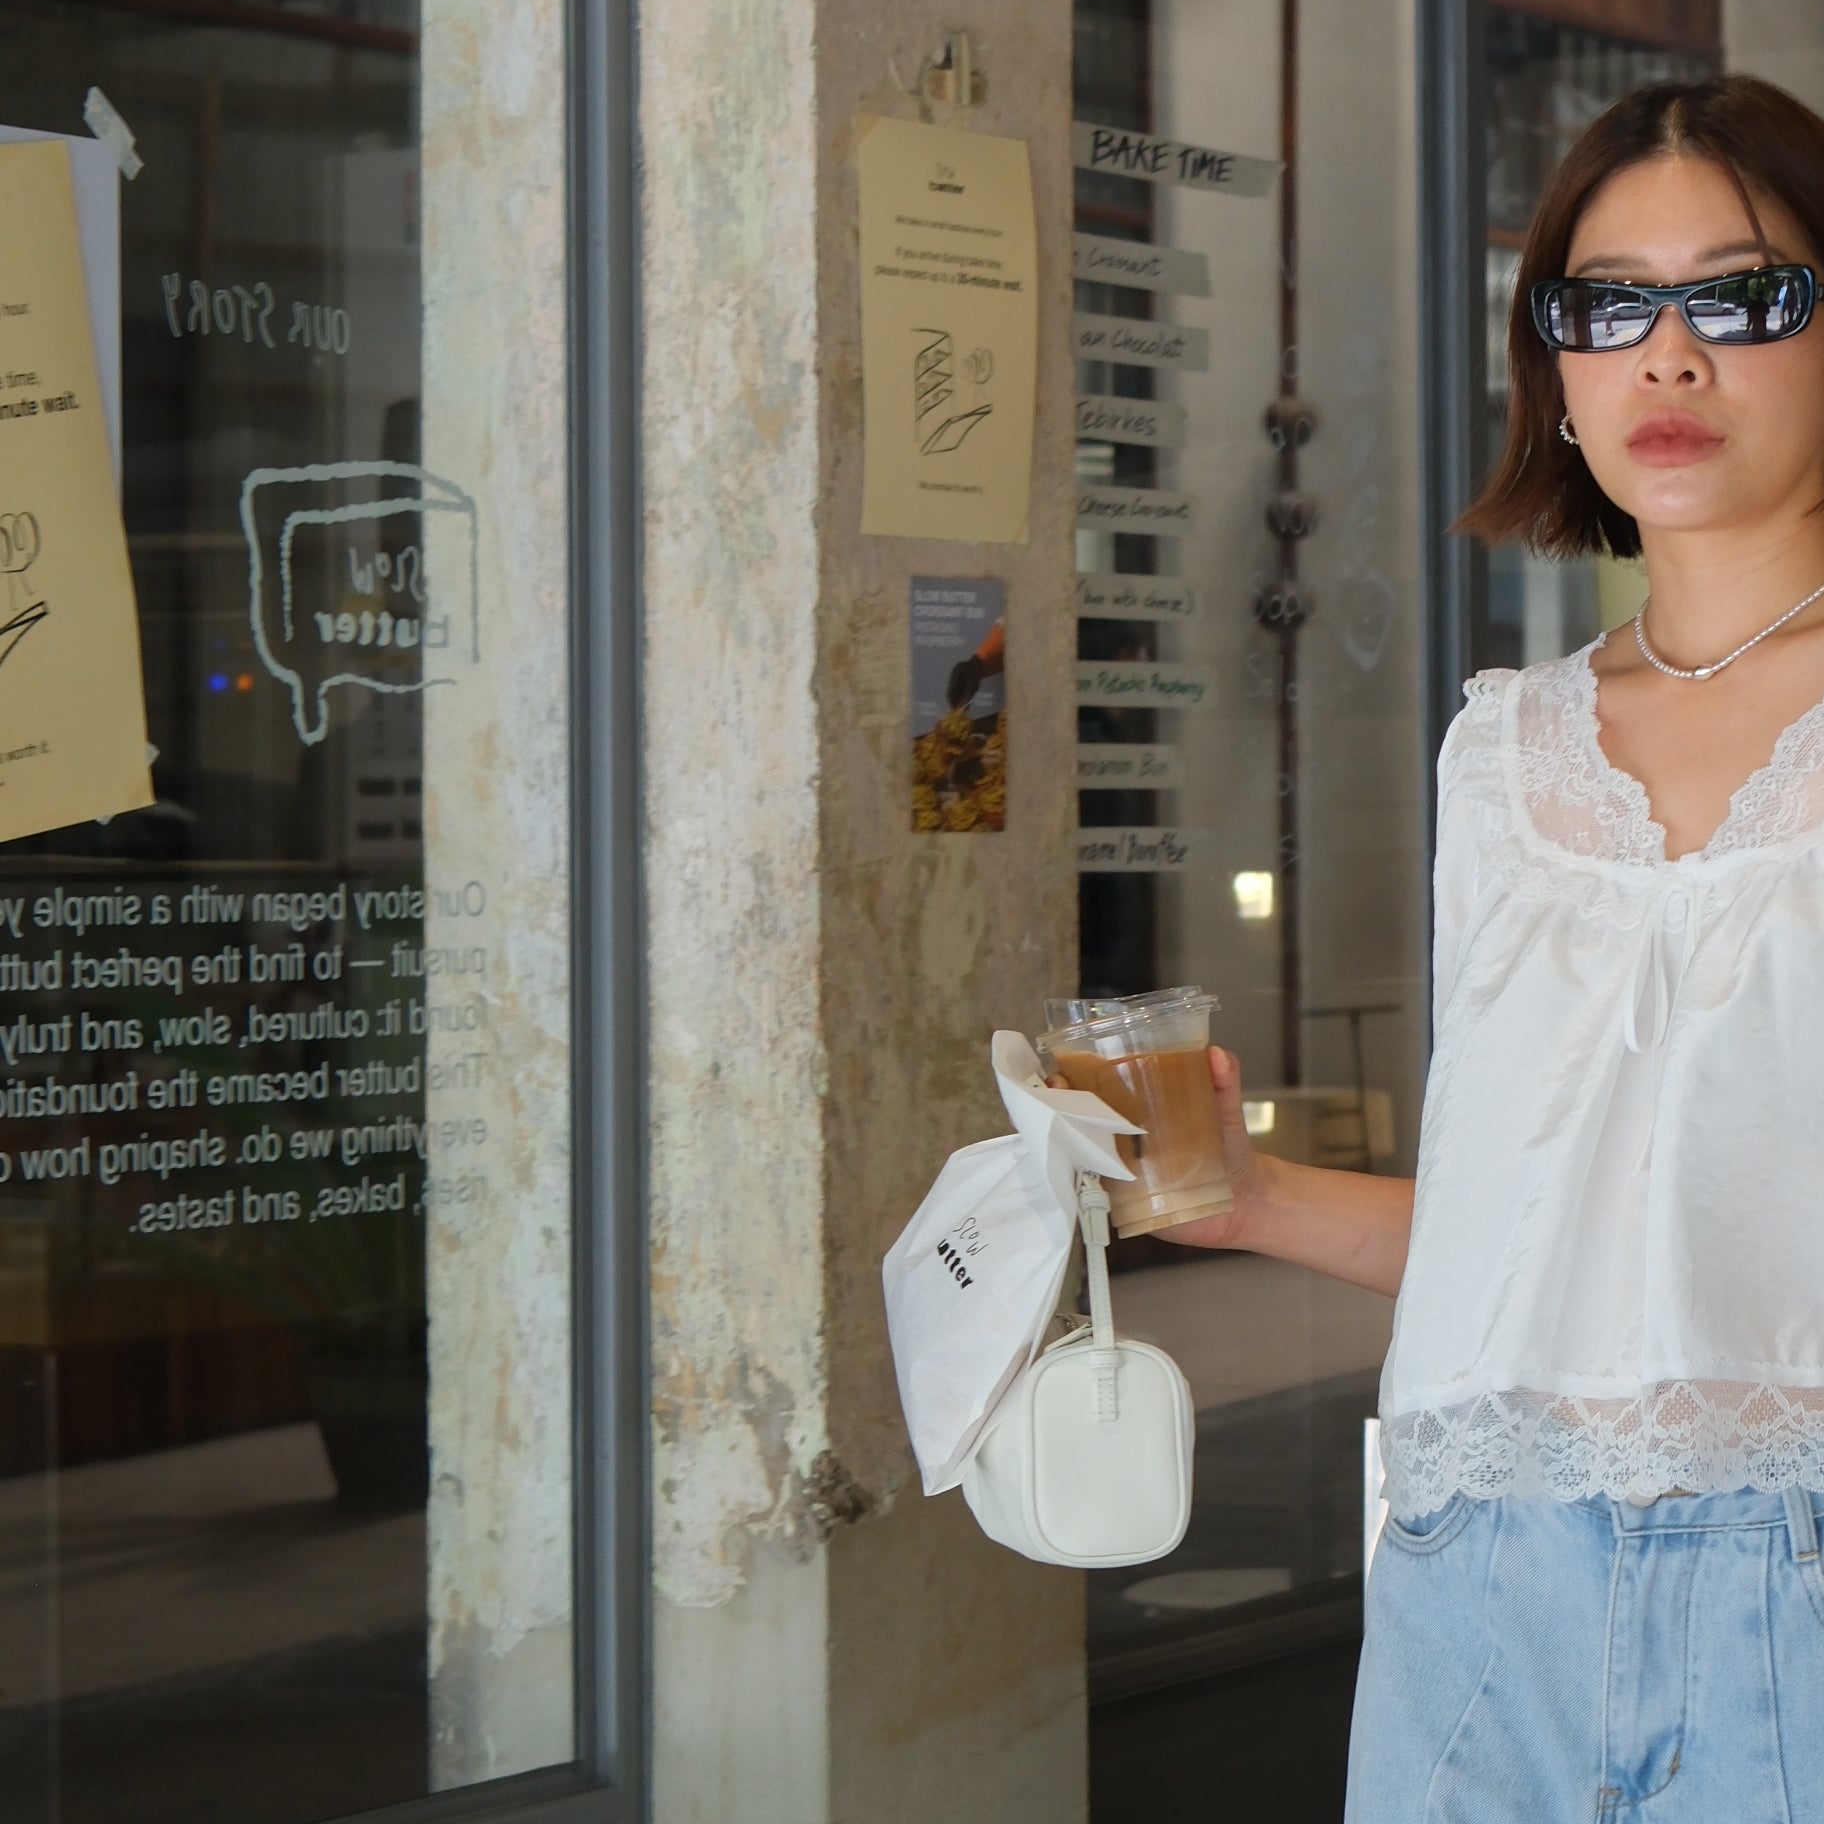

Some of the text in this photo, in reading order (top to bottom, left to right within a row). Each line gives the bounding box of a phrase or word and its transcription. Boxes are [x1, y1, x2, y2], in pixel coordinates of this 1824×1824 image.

[1092, 130, 1235, 182] BAKE TIME
[937, 1239, 973, 1289] utter
